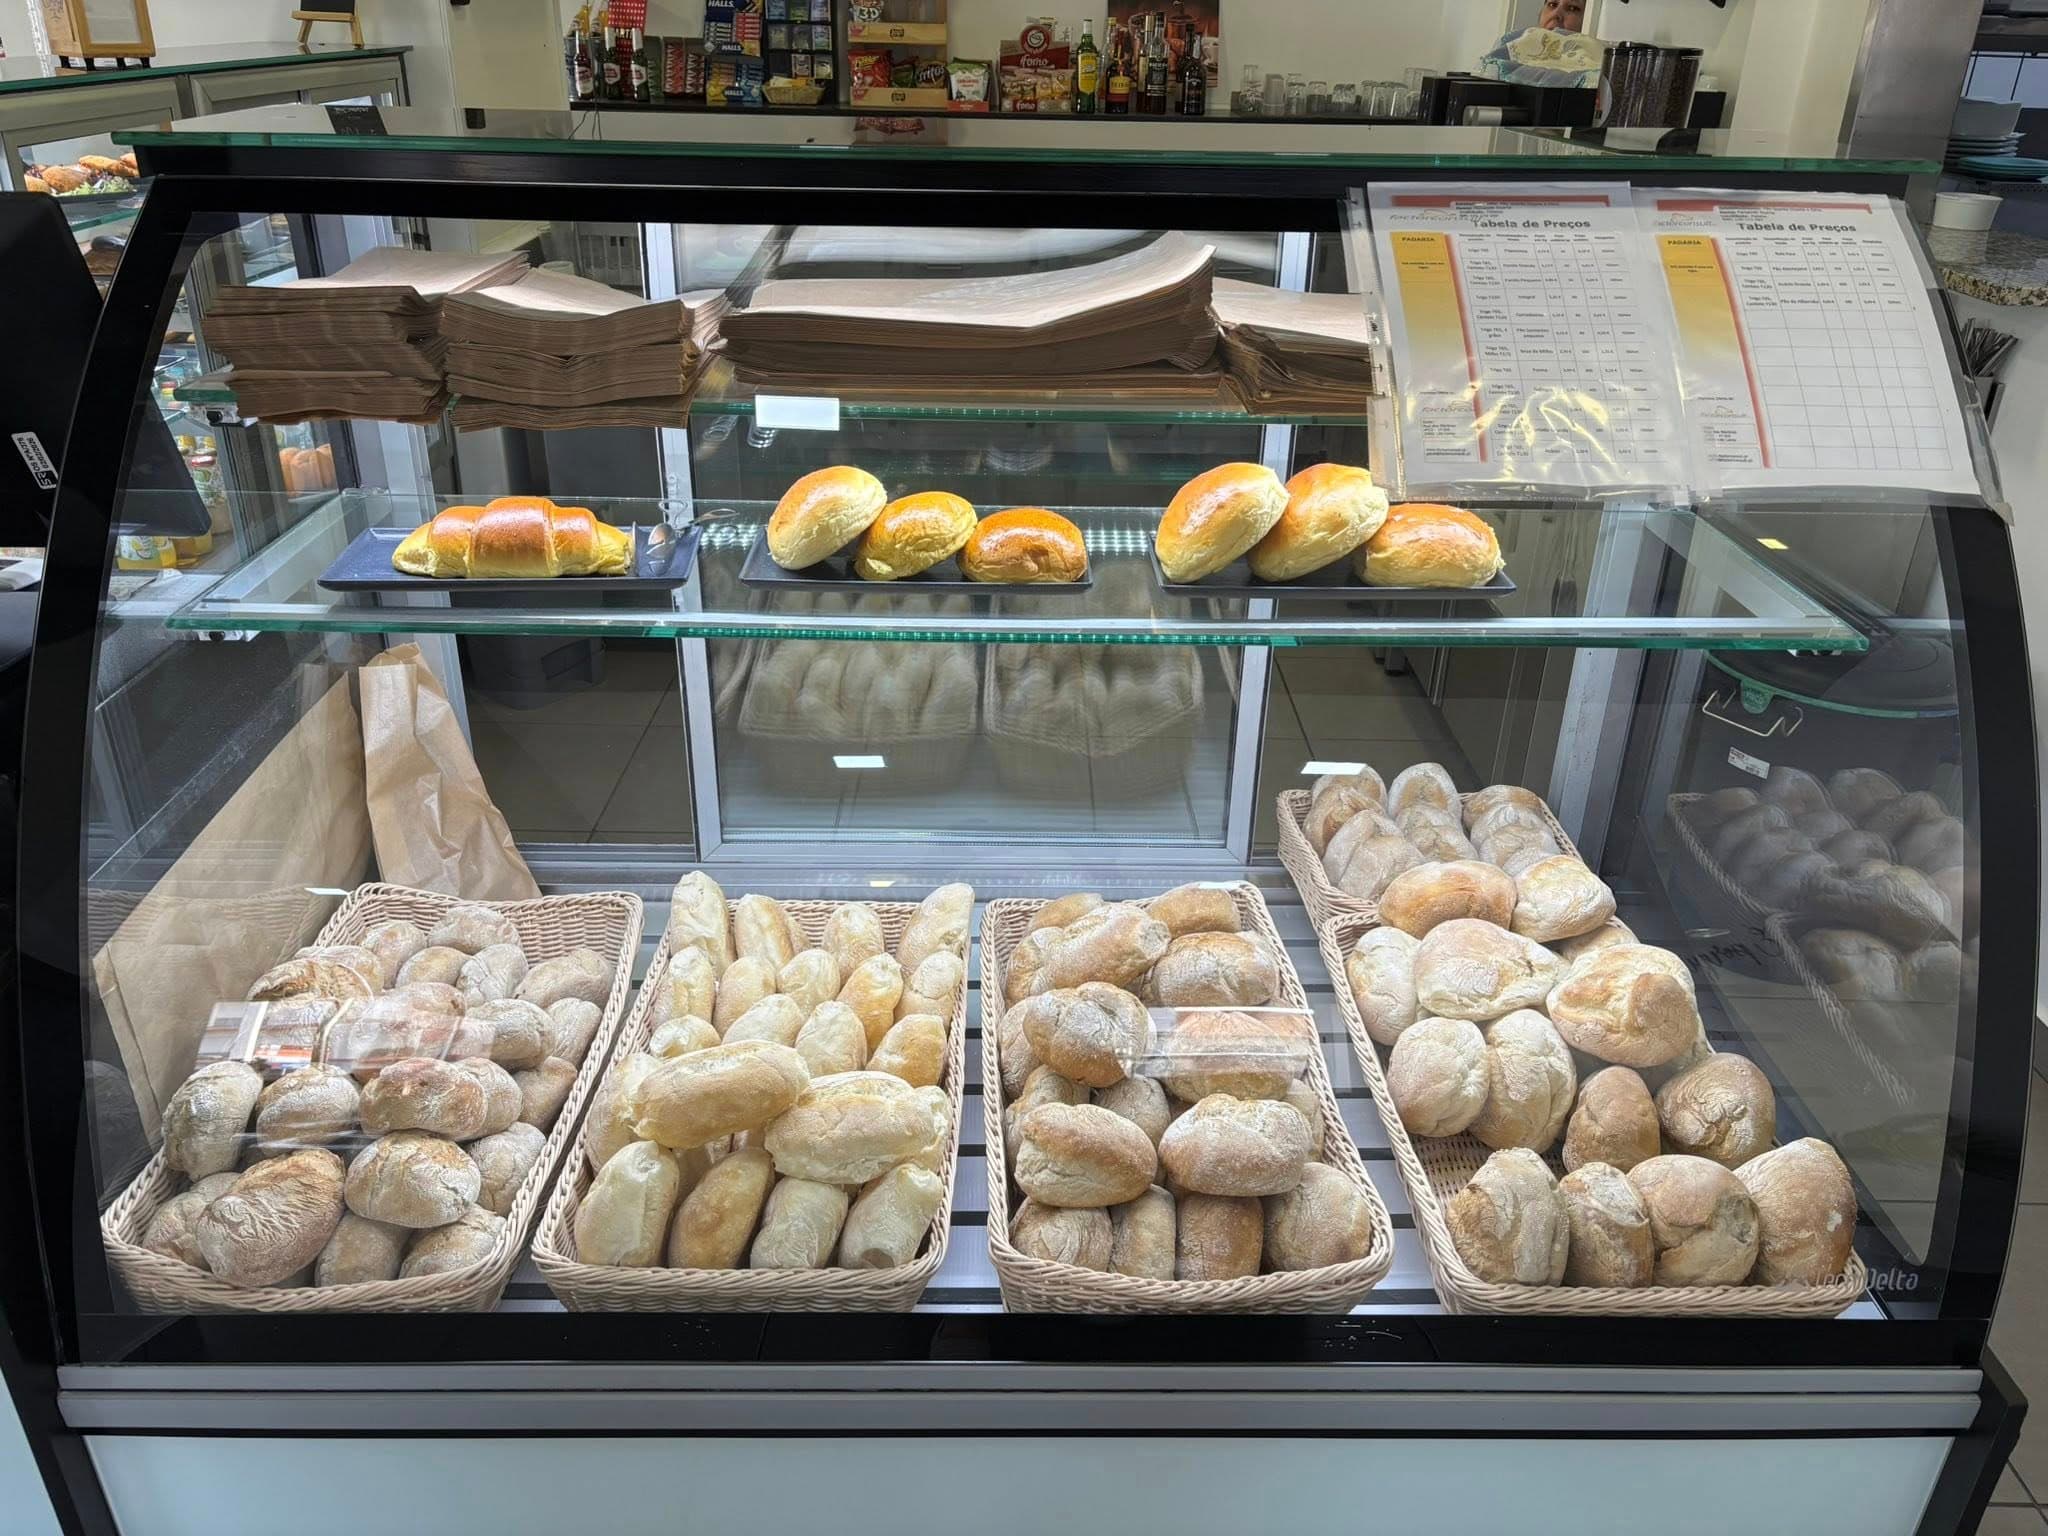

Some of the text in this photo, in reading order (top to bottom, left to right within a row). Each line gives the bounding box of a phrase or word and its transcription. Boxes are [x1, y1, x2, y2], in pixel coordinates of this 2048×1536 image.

[1474, 219, 1591, 230] Tabela de Preços
[1737, 222, 1857, 234] Tabela de Preços
